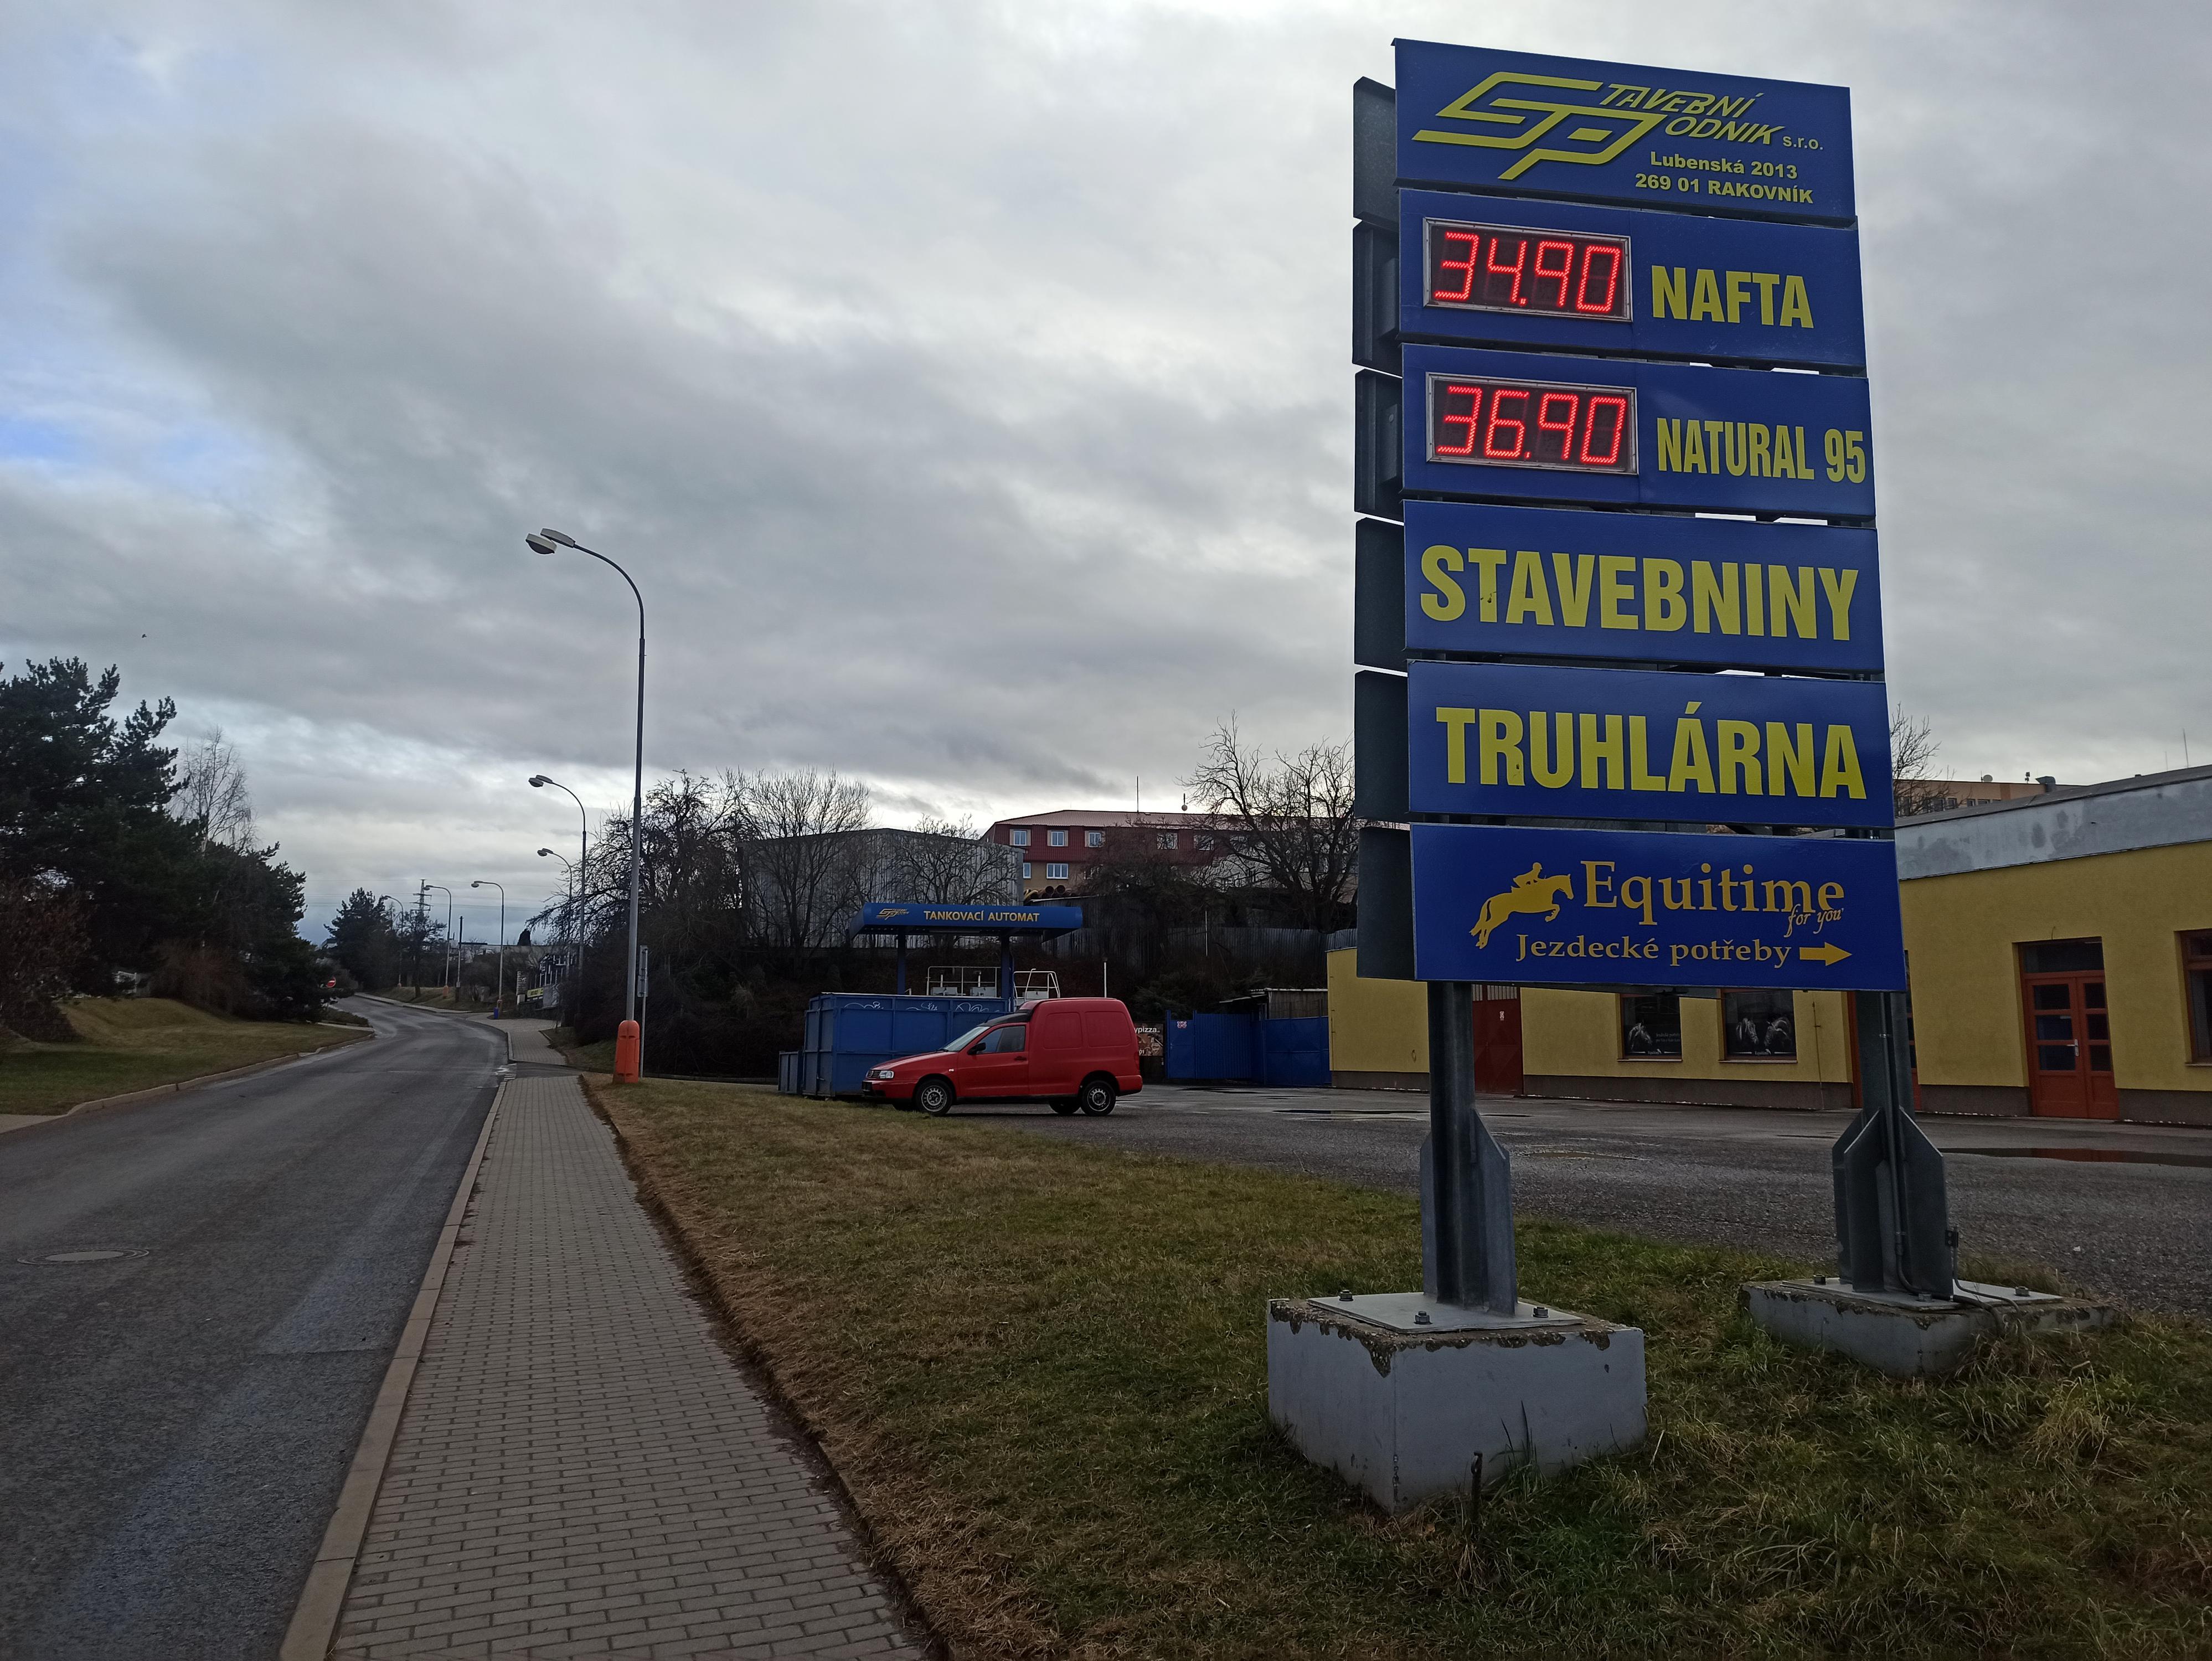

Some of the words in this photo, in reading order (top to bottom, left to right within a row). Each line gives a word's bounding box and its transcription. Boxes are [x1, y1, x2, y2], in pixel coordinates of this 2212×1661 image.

[1650, 152, 1745, 174] Lubenská
[1752, 161, 1797, 179] 2013
[1783, 135, 1823, 150] s.r.o.
[1635, 173, 1672, 191] 269
[1678, 178, 1699, 193] 01
[1709, 182, 1813, 204] RAKOVNÍK
[1435, 232, 1621, 313] 34.90
[1652, 265, 1814, 329] NAFTA
[1437, 386, 1627, 464] 36.90
[1657, 417, 1815, 480] NATURAL
[1826, 429, 1866, 484] 95
[1420, 545, 1859, 641] STAVEBNINY
[1436, 701, 1867, 800] TRUHLÁRNA
[924, 910, 984, 921] TANKOVACÍ
[988, 912, 1040, 922] AUTOMAT
[1580, 860, 1844, 926] Equitime
[1783, 904, 1811, 937] for
[1516, 934, 1659, 962] Jezdecké
[1669, 940, 1791, 968] potřeby
